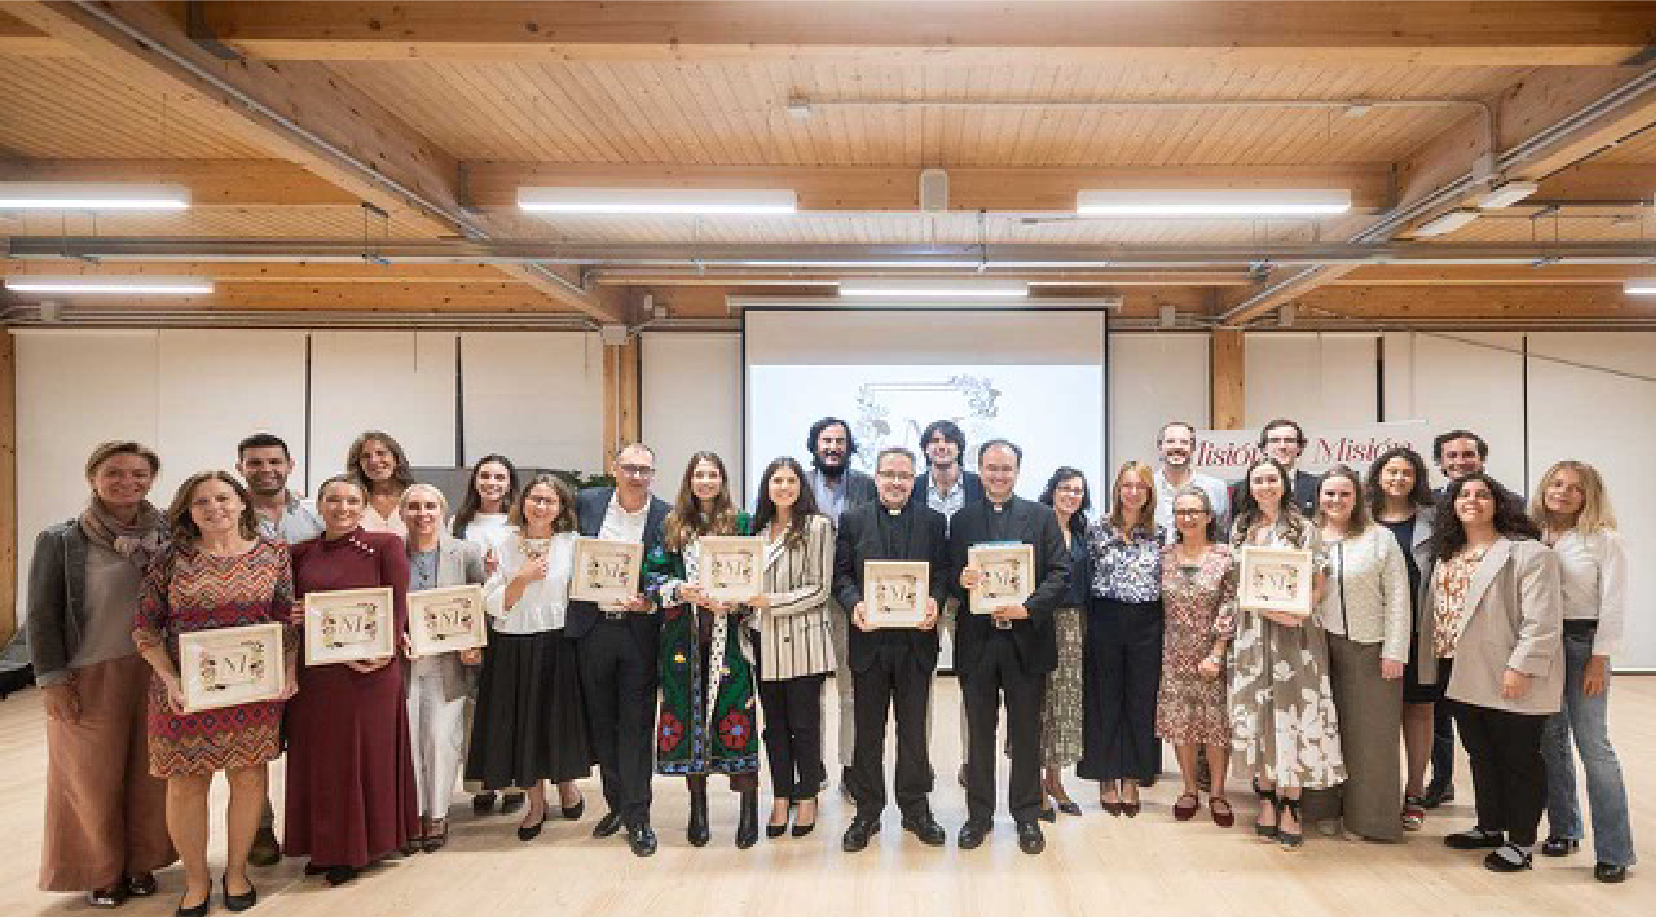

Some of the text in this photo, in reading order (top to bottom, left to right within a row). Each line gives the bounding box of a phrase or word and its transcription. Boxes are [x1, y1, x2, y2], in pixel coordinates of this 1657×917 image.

[339, 615, 362, 634] M
[439, 610, 460, 626] M
[223, 654, 247, 674] M
